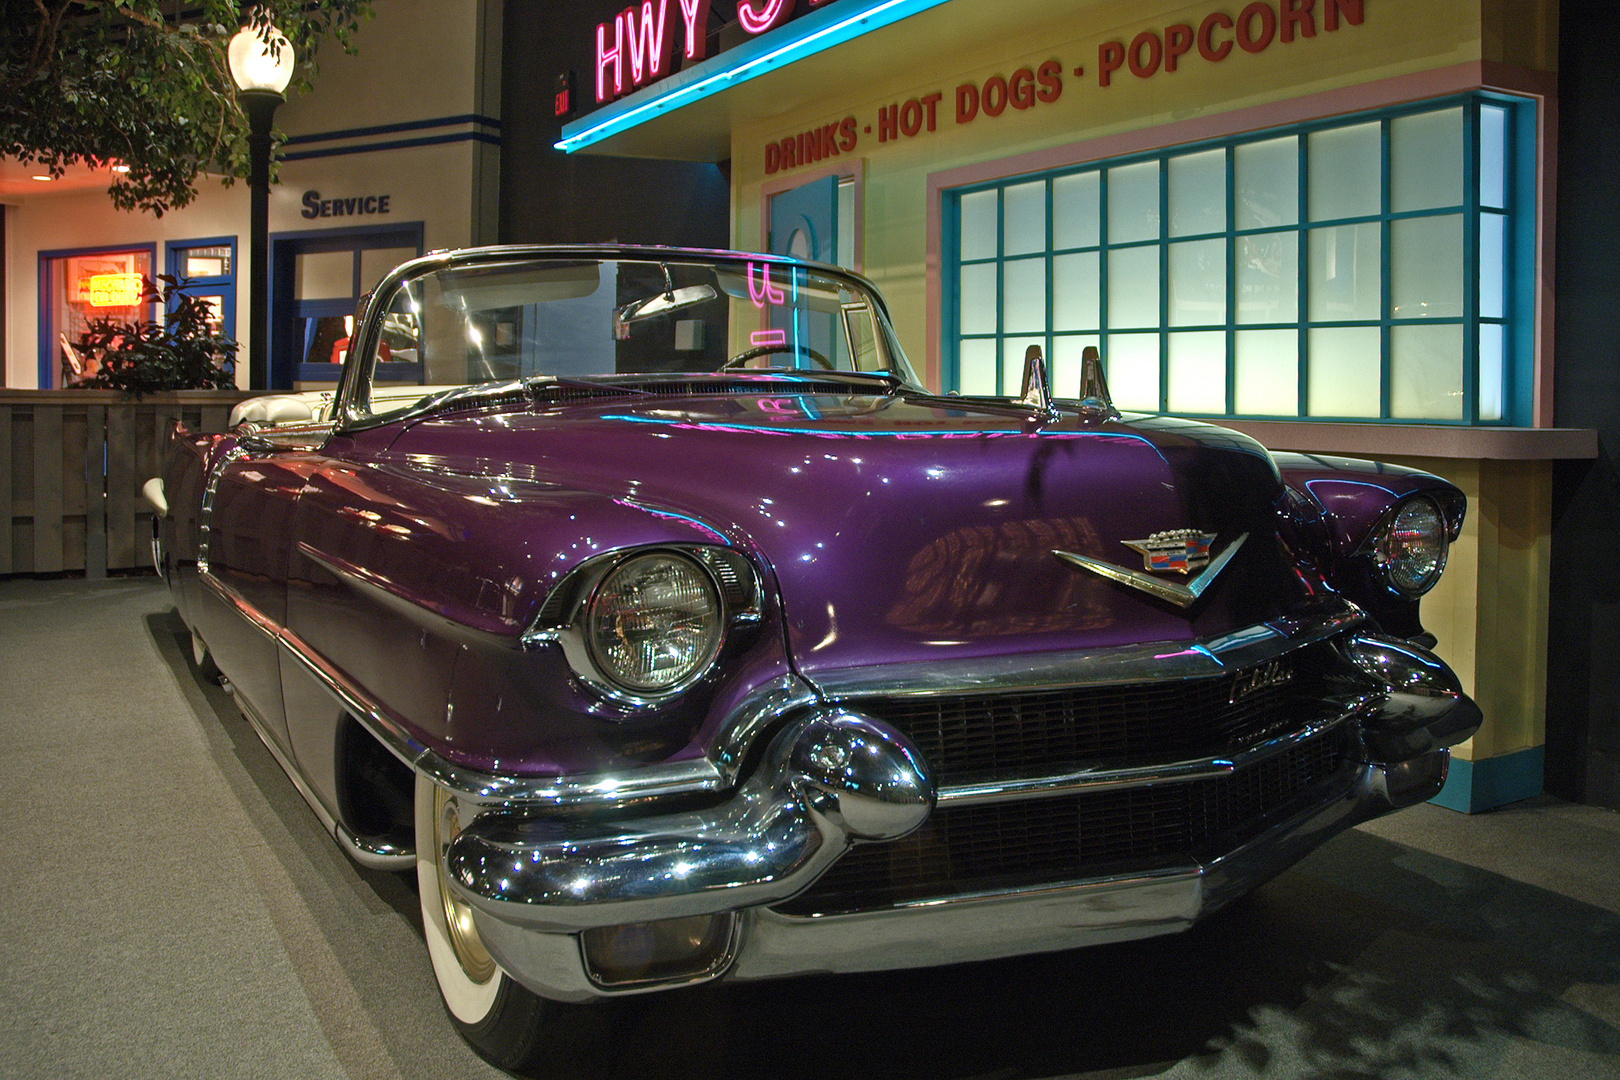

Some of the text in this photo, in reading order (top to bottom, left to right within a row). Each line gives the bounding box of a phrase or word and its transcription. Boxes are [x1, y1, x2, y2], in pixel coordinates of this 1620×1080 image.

[596, 0, 708, 103] HWY
[764, 0, 1365, 175] DRINKS HOT DOGS POPCORN
